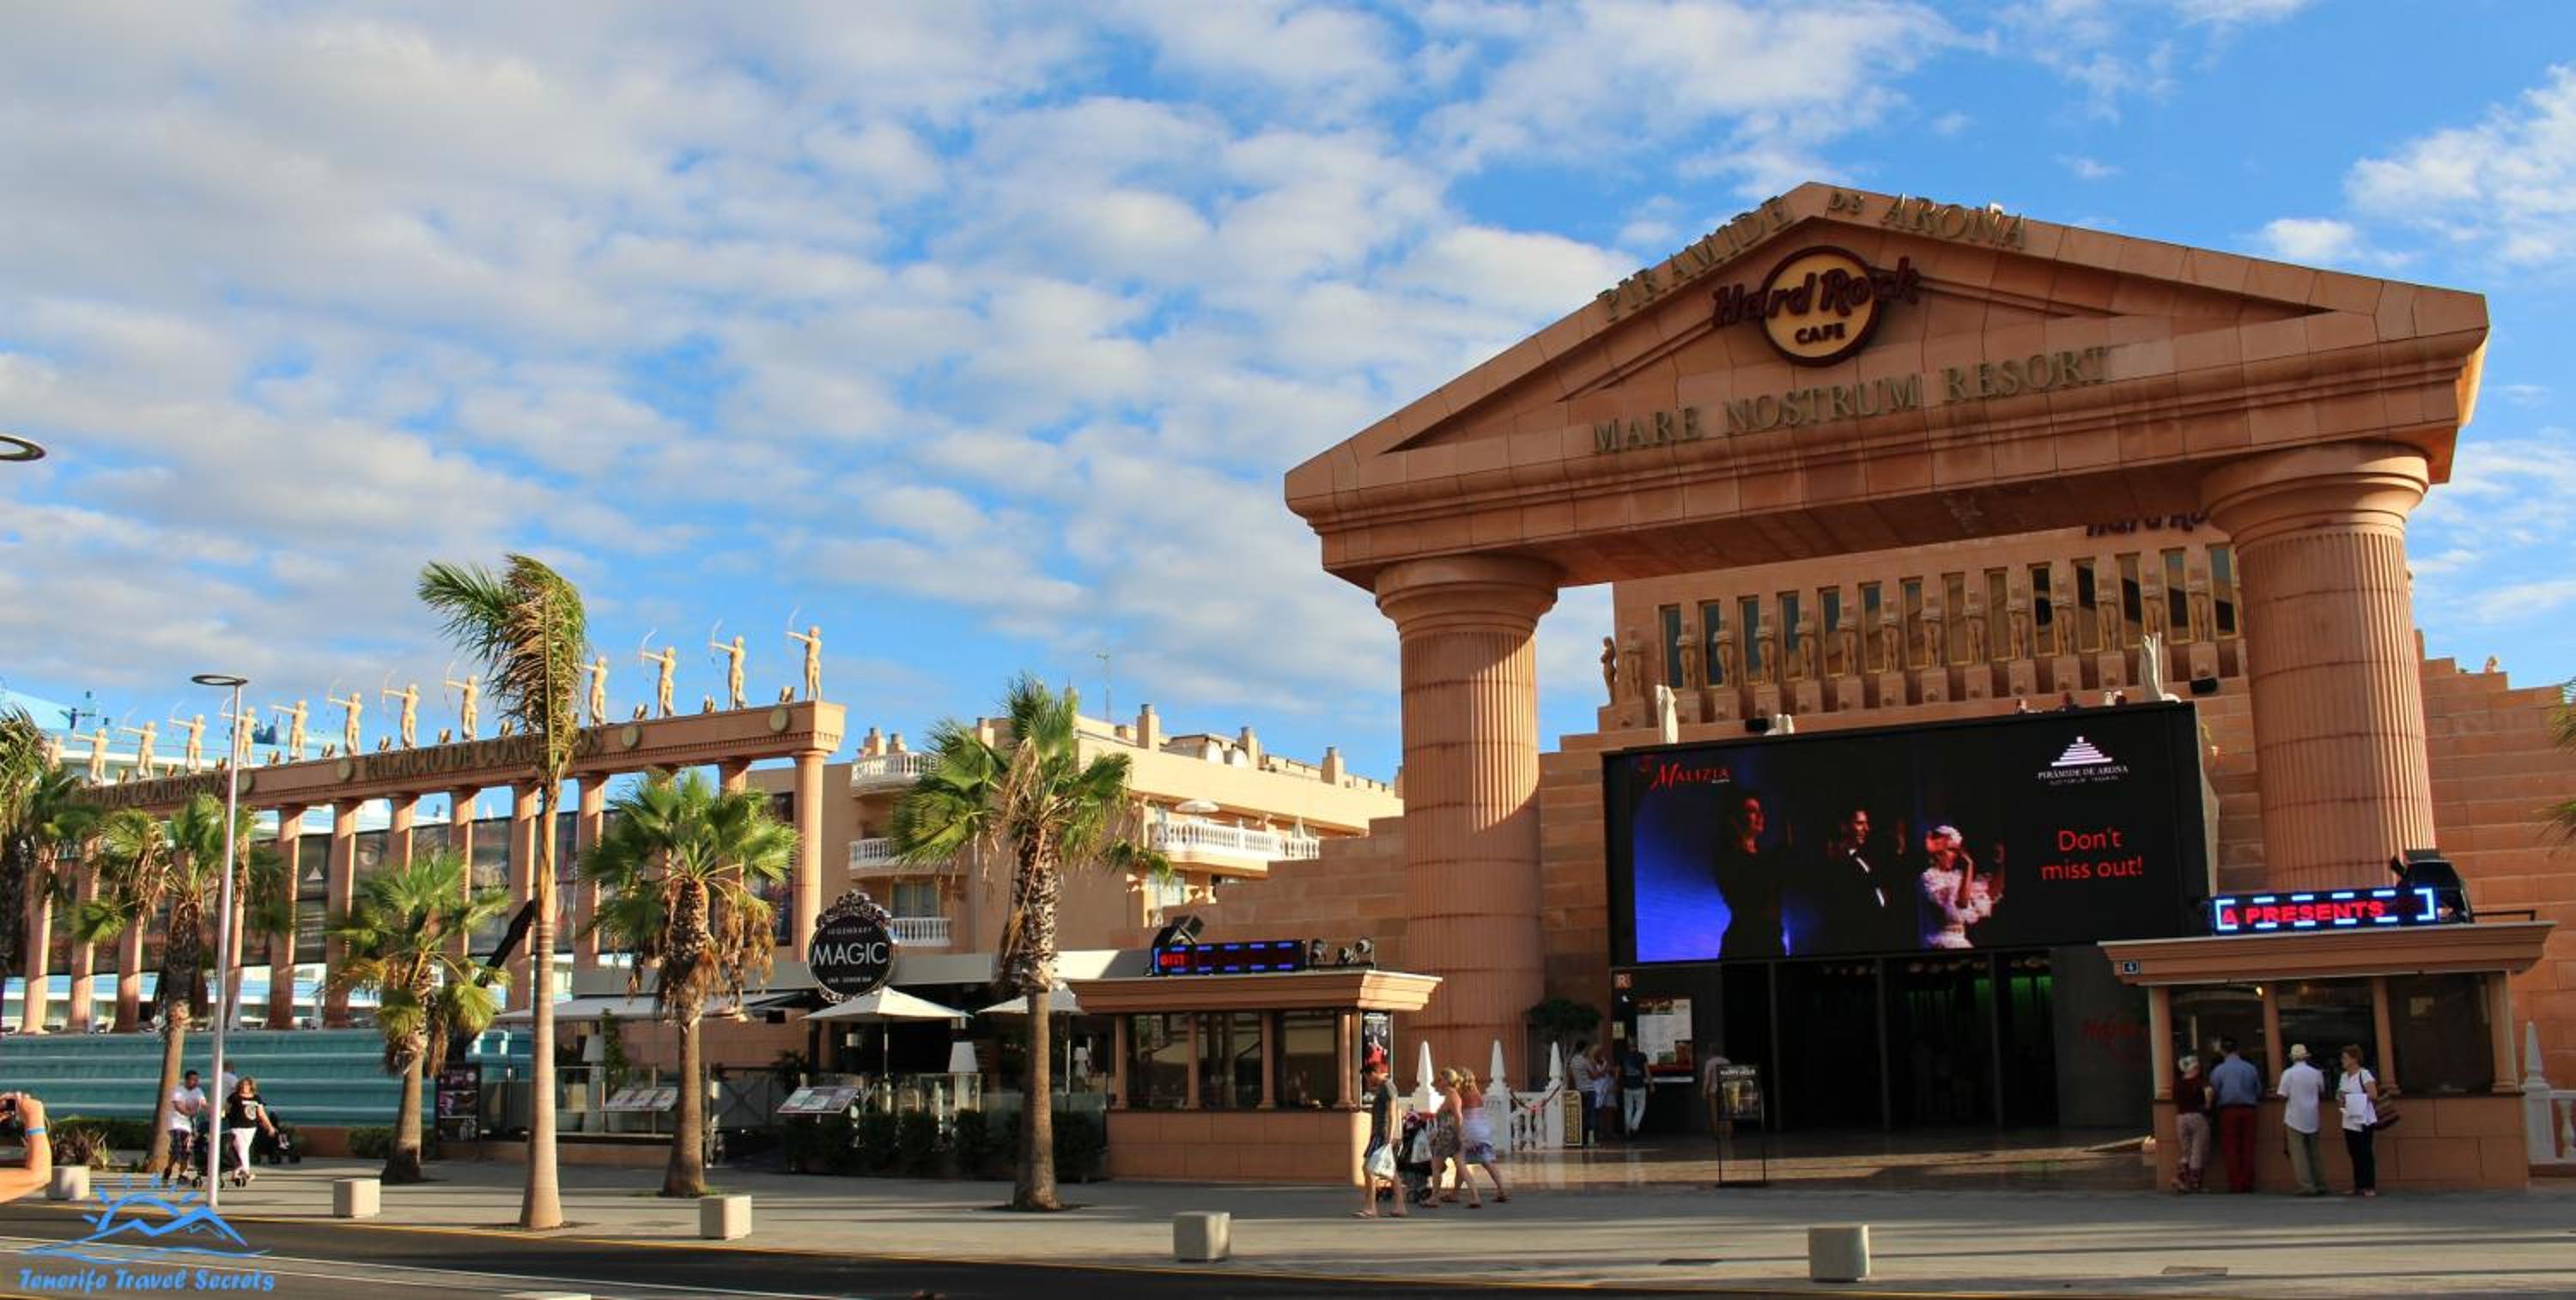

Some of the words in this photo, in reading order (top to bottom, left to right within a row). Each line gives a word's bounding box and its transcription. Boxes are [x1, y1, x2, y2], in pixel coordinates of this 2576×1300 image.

[1882, 192, 2026, 249] ARONA
[1712, 272, 1817, 329] Hard
[1820, 257, 1922, 317] Rock
[1795, 322, 1846, 344] CAFE
[1594, 407, 1704, 453] MARE
[1724, 373, 1924, 434] NOSTRUM
[1941, 346, 2108, 403] RESORT
[2057, 827, 2123, 853] Don't
[2042, 859, 2091, 880] miss
[2097, 855, 2143, 878] out!
[2245, 901, 2385, 925] PRESENTS
[811, 941, 888, 966] MAGIC
